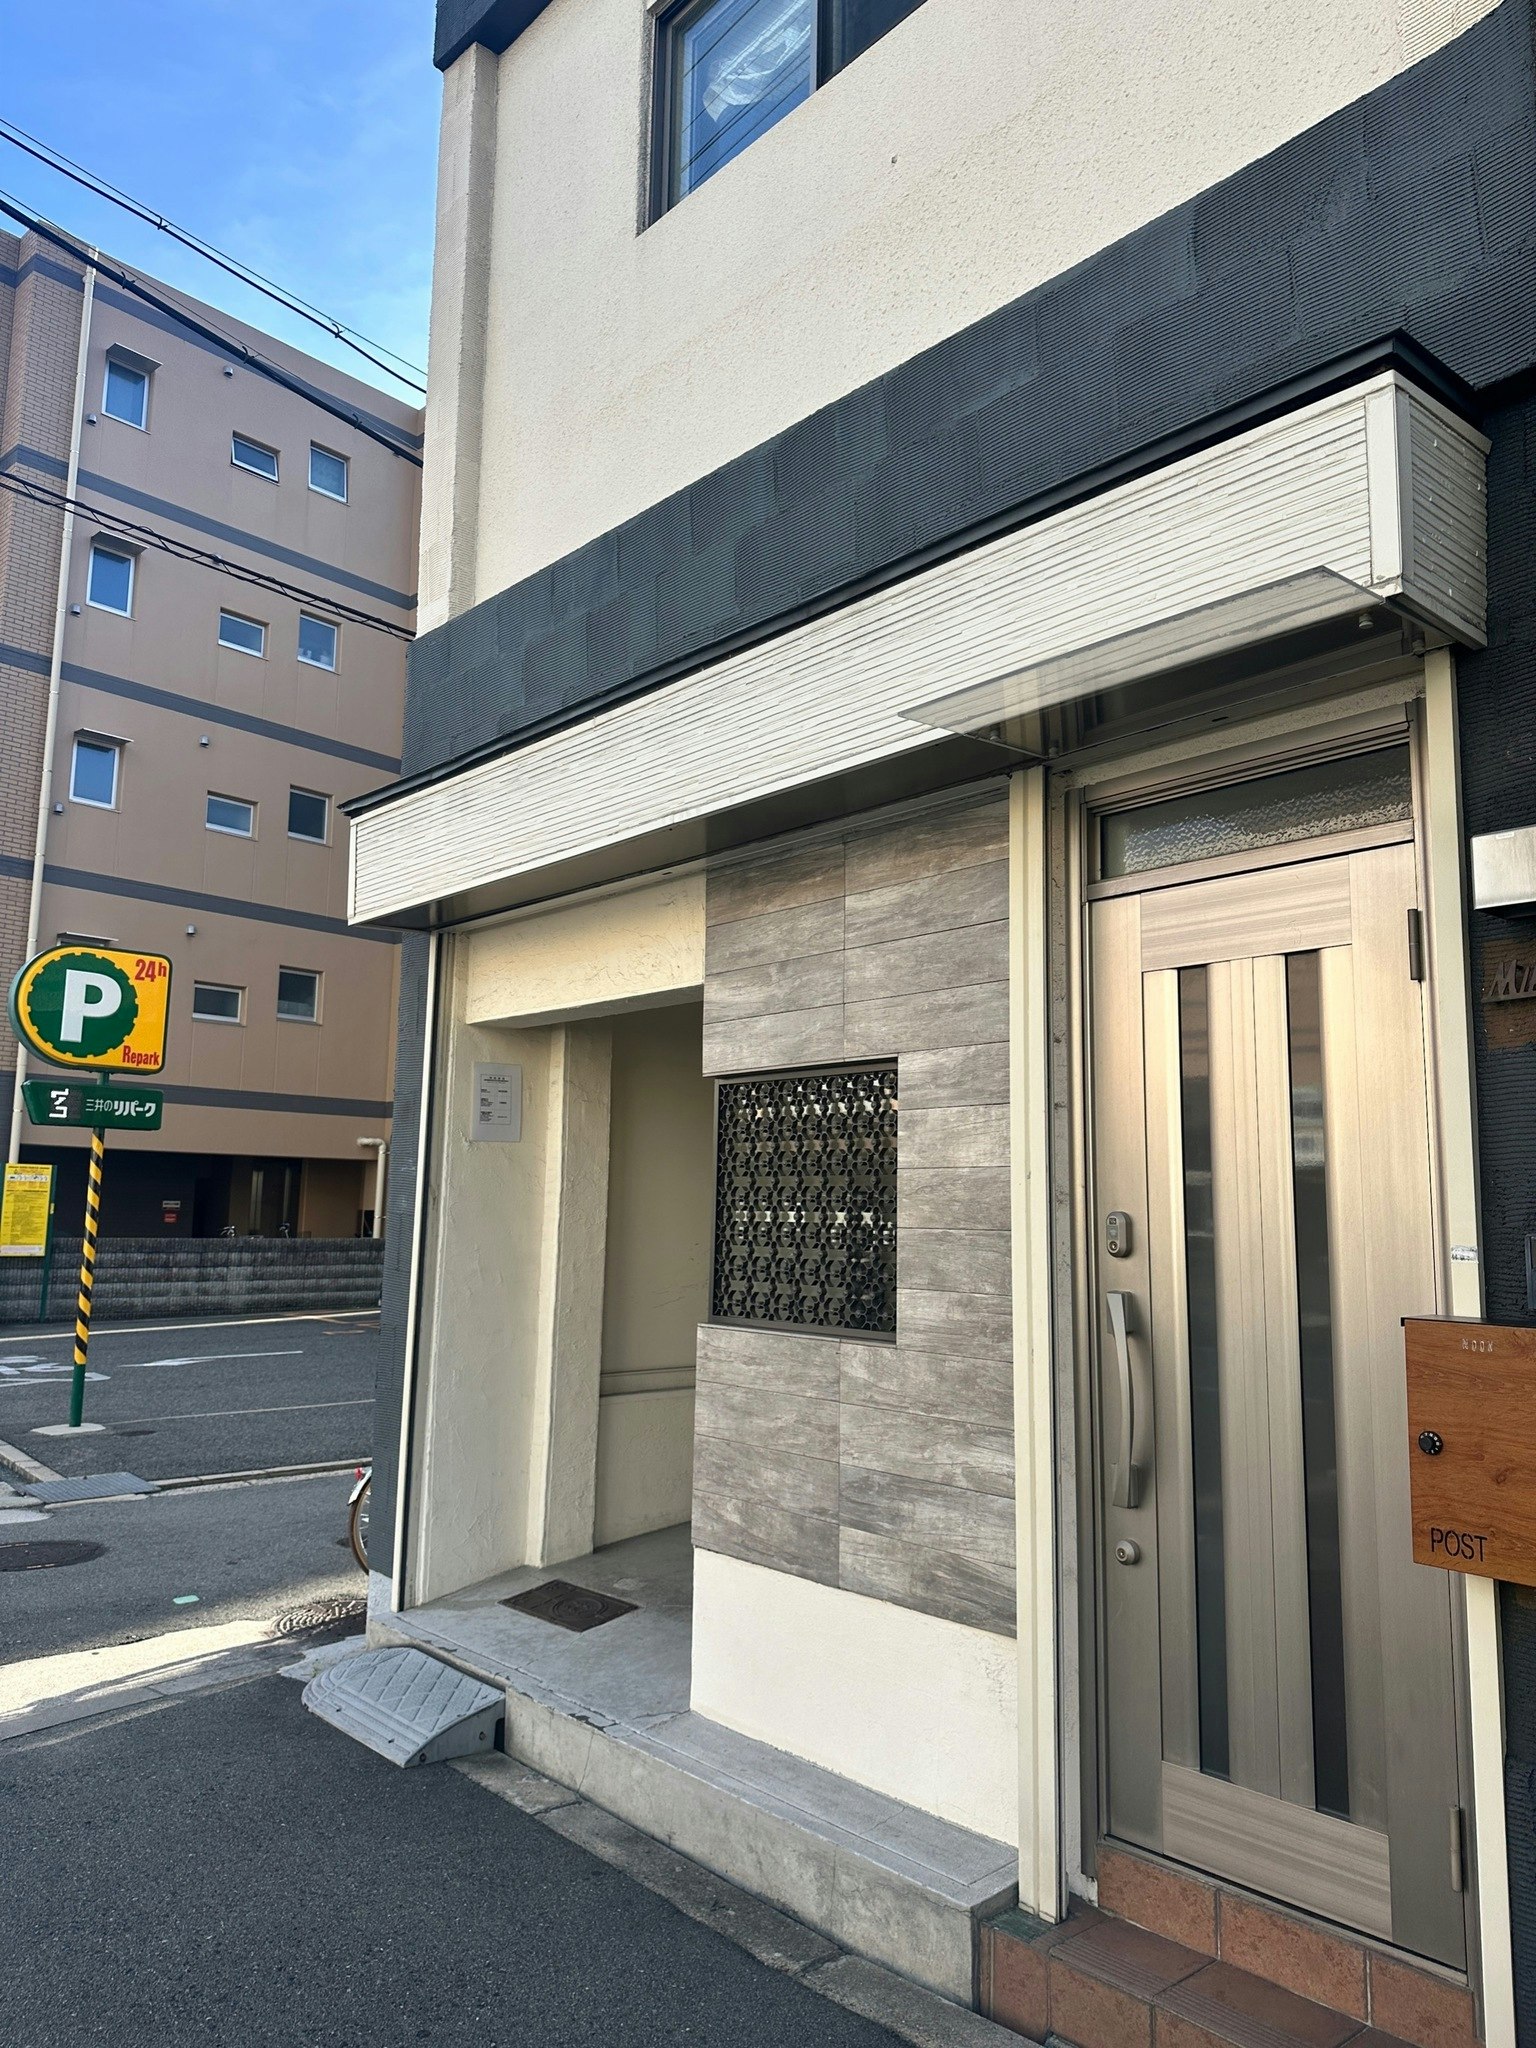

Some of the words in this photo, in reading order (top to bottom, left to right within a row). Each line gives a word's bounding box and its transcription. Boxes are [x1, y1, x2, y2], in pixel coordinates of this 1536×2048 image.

[135, 959, 167, 982] 24h
[60, 968, 122, 1043] P
[122, 1045, 160, 1067] Repark
[85, 1098, 156, 1118] 三井のリパーク
[1430, 1527, 1488, 1562] POST
